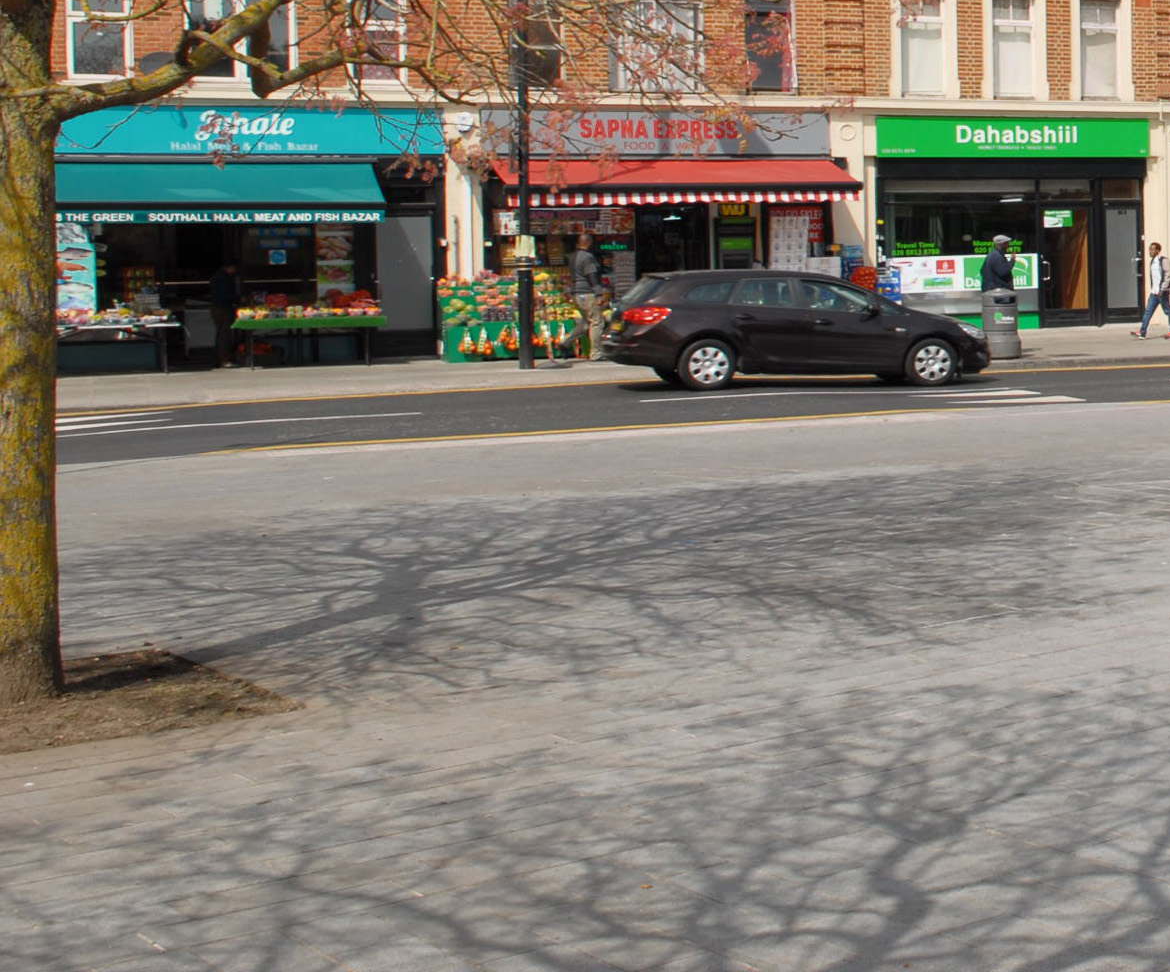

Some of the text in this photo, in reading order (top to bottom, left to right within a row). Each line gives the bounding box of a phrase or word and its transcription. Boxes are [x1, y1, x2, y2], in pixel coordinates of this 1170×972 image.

[580, 118, 738, 140] SAPNA EXPRESS
[955, 125, 1078, 144] Dahabshiil
[170, 142, 201, 151] Halal
[257, 142, 282, 151] Fish
[624, 141, 655, 151] FOOD
[65, 213, 89, 222] THE
[92, 213, 134, 222] GREEN
[148, 213, 211, 222] SOUTHALL
[214, 213, 252, 222] HALAL
[254, 213, 286, 222] MEAT
[287, 213, 312, 222] AND
[315, 213, 340, 222] FISH
[343, 212, 381, 221] BAZAR
